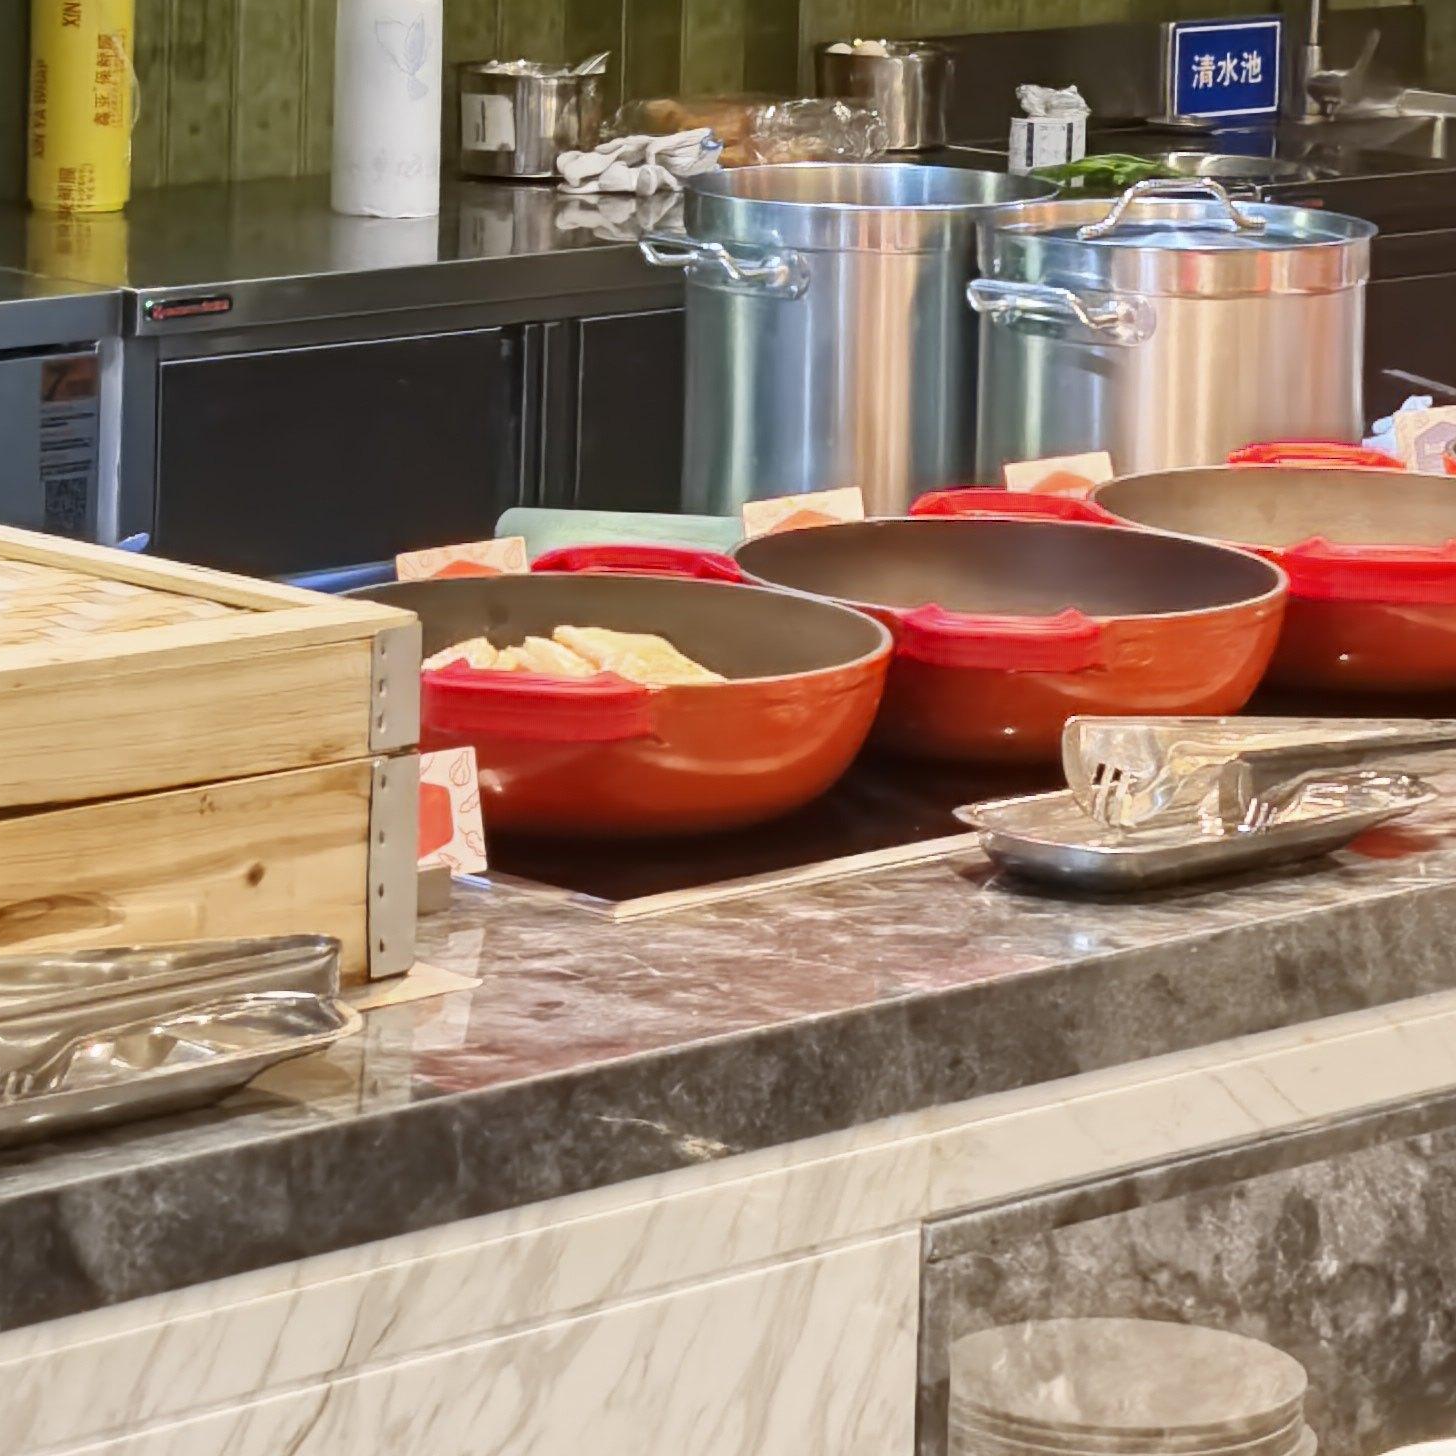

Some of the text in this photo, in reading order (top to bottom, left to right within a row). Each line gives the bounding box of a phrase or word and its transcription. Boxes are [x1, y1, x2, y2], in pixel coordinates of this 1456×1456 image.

[62, 3, 82, 29] XIN
[1191, 50, 1263, 89] 清水池
